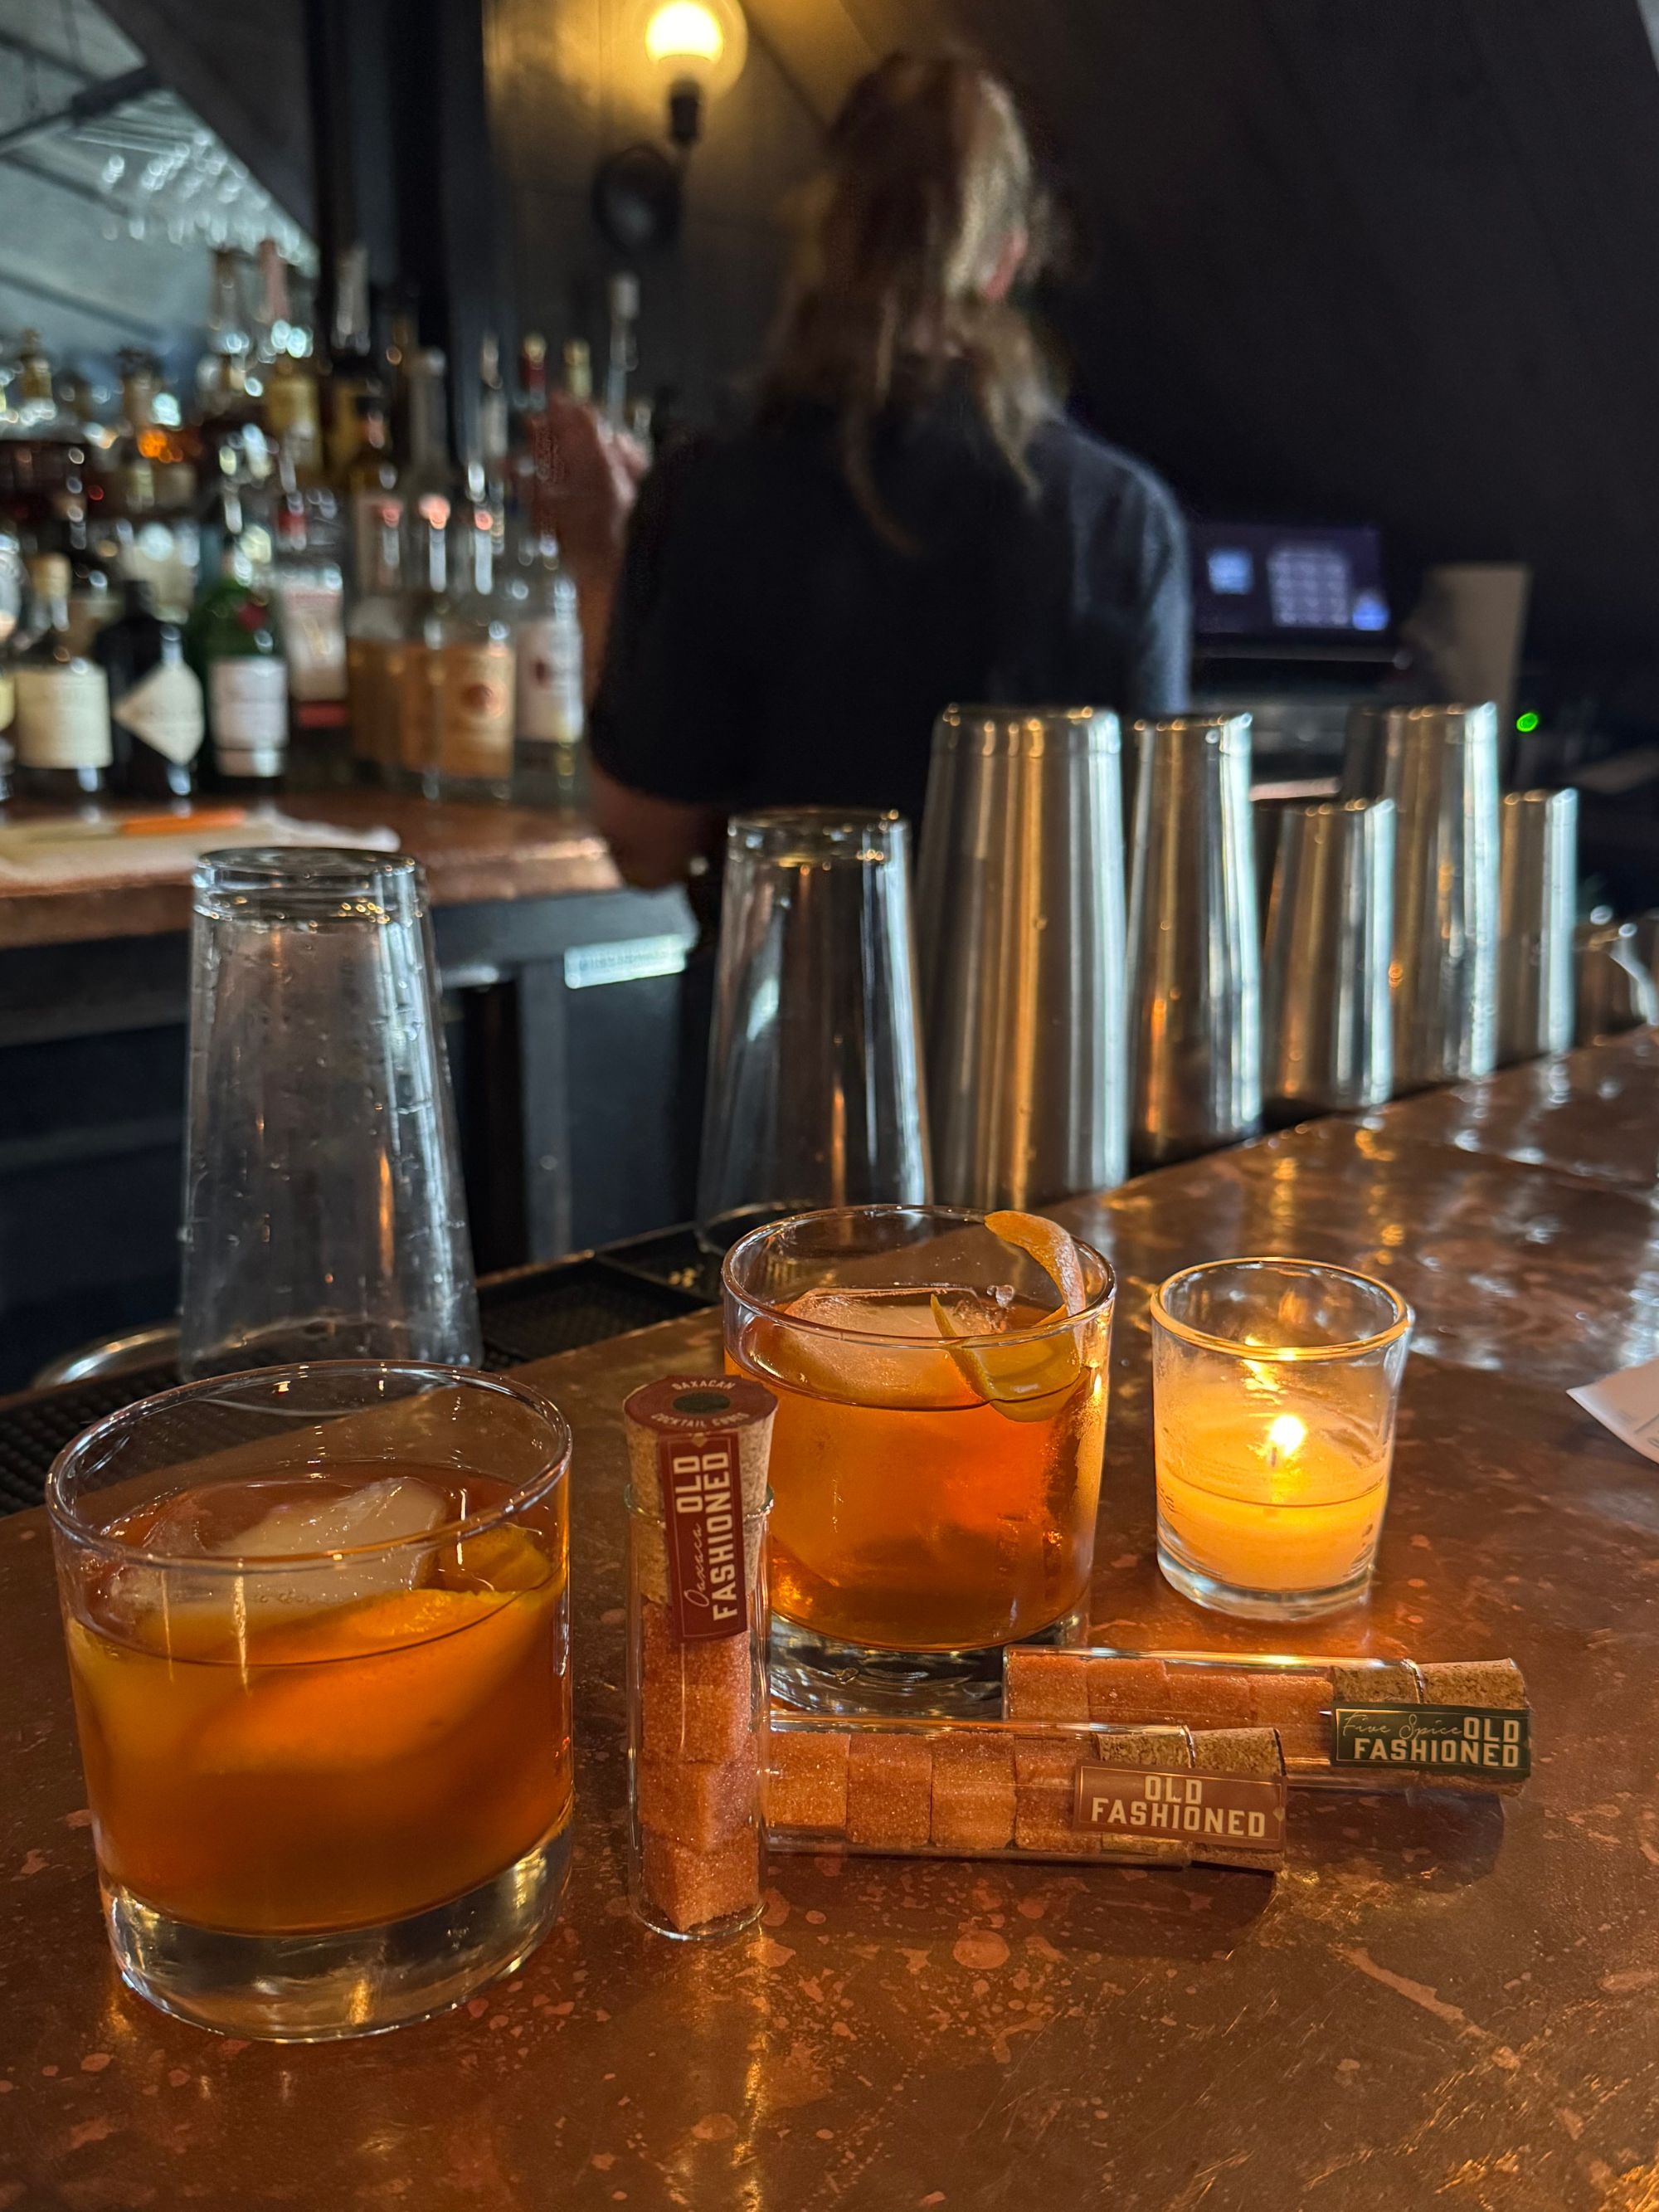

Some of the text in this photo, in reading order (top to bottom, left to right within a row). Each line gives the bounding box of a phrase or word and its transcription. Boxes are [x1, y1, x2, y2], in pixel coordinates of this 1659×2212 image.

[672, 1380, 736, 1391] OAXACAN
[650, 1412, 707, 1427] COCKTAIL
[673, 1455, 709, 1608] Oaxaca OLD
[702, 1452, 737, 1620] FASHIONED
[1342, 1713, 1520, 1743] Five Spice OLD
[1354, 1737, 1519, 1768] FASHIONED
[1145, 1775, 1202, 1805] OLD
[1091, 1796, 1265, 1838] FASHIONED
